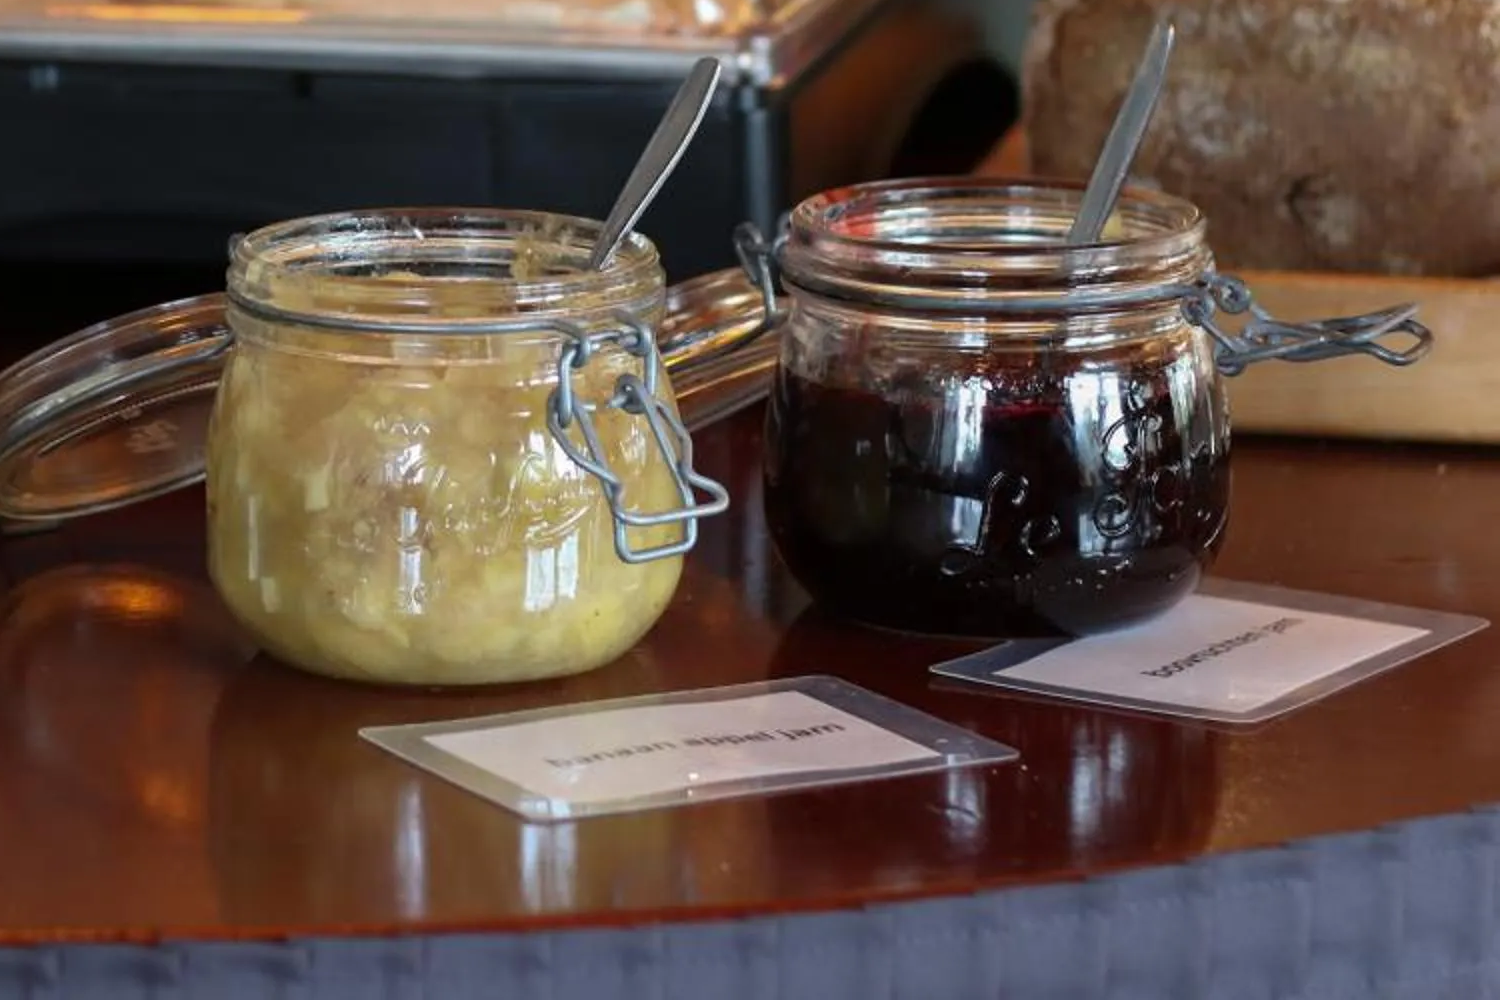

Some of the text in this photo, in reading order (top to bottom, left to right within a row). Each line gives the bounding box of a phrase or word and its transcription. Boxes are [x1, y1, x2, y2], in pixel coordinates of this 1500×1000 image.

[545, 722, 846, 767] banaan appel jam
